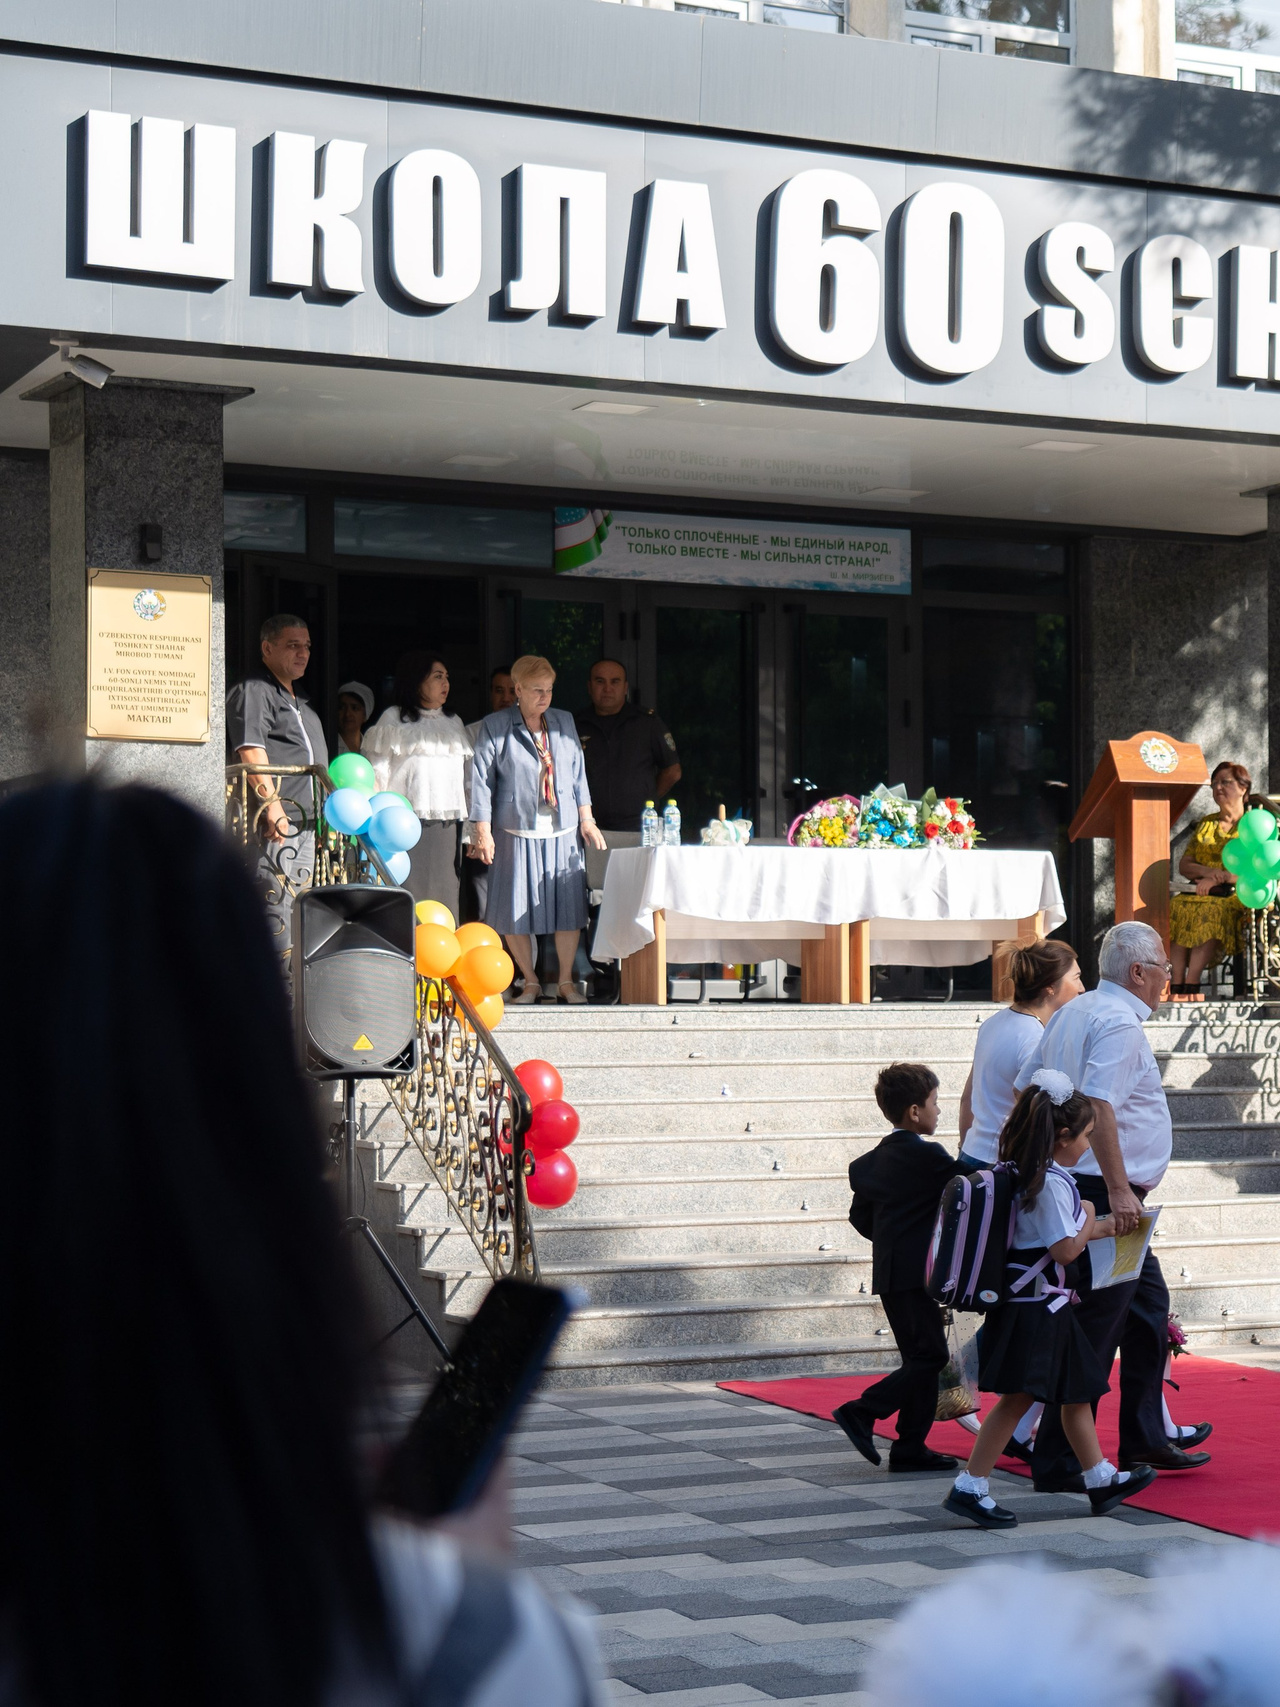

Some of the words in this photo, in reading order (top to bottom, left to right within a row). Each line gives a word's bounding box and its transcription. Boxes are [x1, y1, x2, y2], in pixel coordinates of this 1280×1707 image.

[80, 109, 728, 332] ШКОЛА
[768, 168, 1004, 374] 60
[616, 526, 670, 539] "ТОЛЬКО
[674, 529, 759, 546] СПЛОЧЁННЫЕ
[771, 536, 790, 547] МЫ
[794, 536, 844, 551] ЕДИНЫЙ
[849, 541, 892, 555] НАРОД,
[628, 543, 677, 556] ТОЛЬКО
[681, 546, 729, 559] ВМЕСТЕ
[741, 550, 761, 561] МЫ
[765, 551, 821, 565] СИЛЬНАЯ
[825, 555, 880, 568] СТРАНА!"
[150, 635, 202, 643] RESPUBLIKASI
[114, 642, 153, 650] TOSHKENT
[92, 685, 163, 694] CHUQURLASHTIRIB
[108, 695, 191, 704] IXTISOSLASHTIRILGAN
[127, 714, 172, 723] MAKTABI
